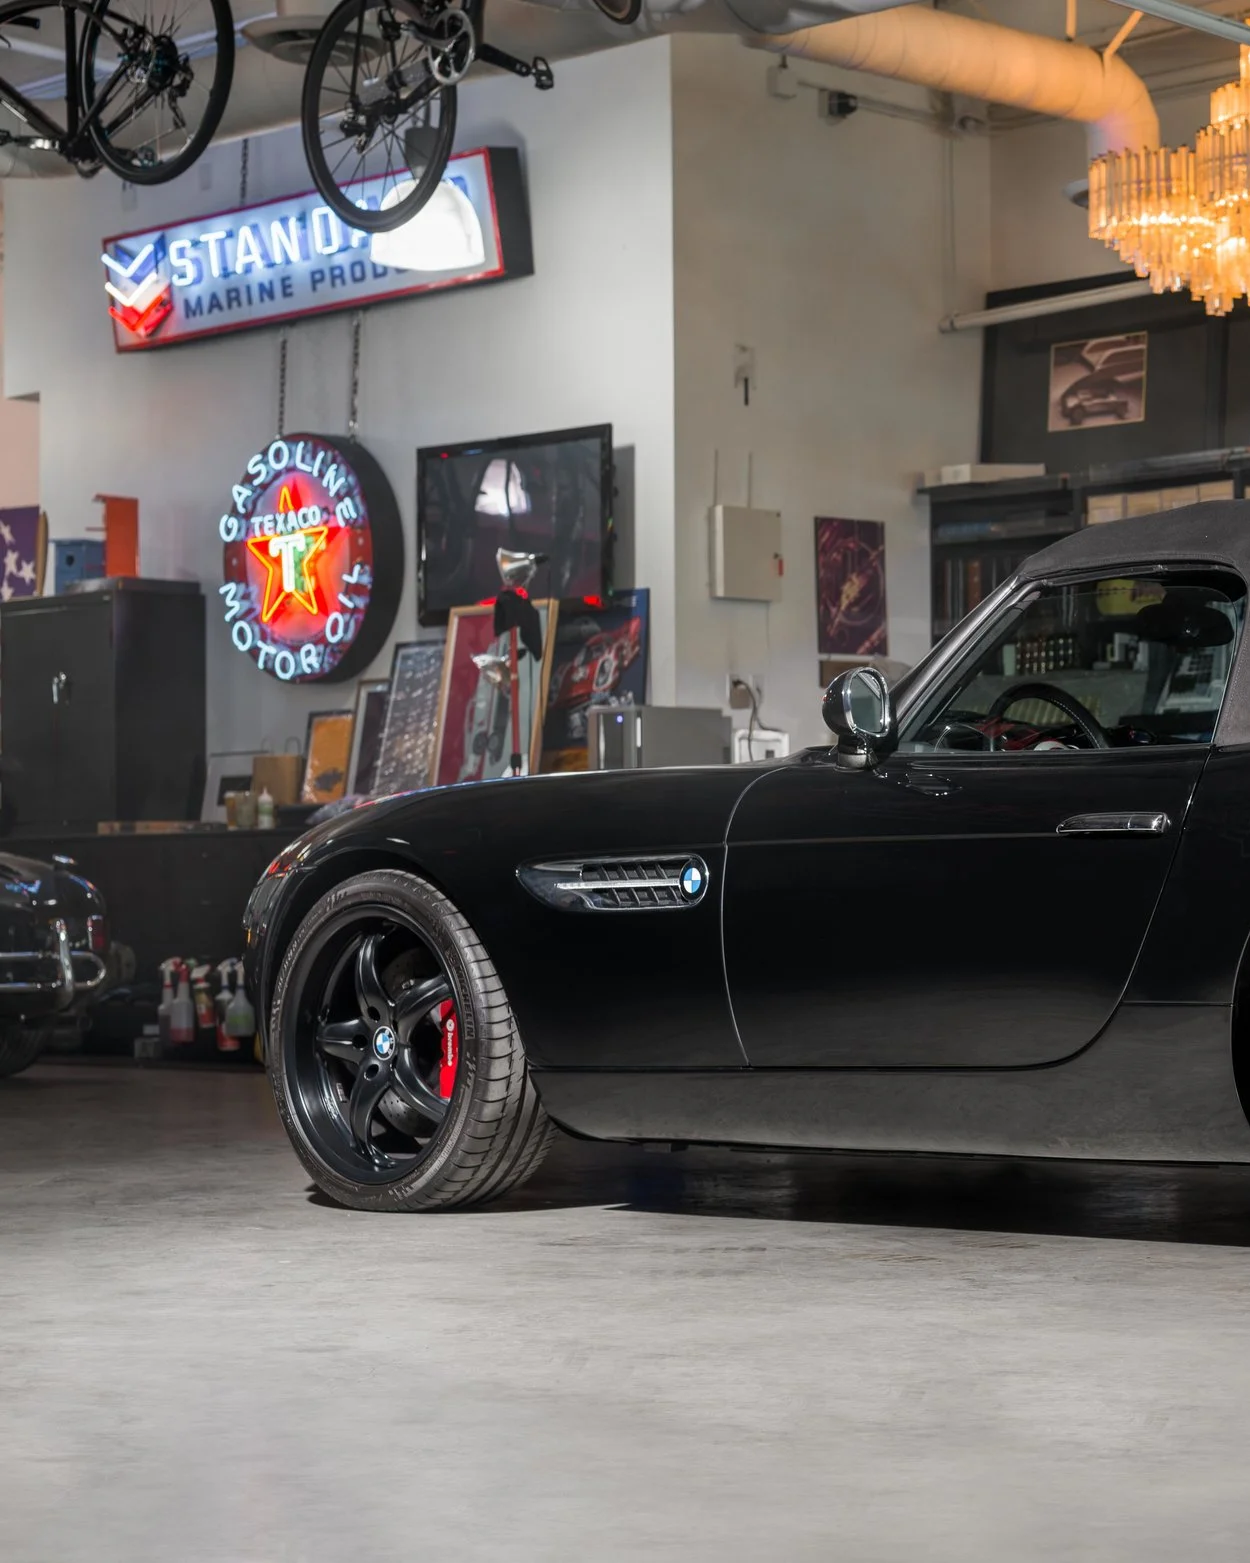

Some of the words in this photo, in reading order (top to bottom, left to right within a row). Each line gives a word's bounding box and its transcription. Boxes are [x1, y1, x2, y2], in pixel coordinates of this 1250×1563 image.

[183, 277, 294, 320] MARINE
[311, 258, 408, 293] PROD
[219, 440, 358, 543] GASOLINE
[251, 506, 322, 537] TEXACO
[269, 532, 306, 592] T
[219, 582, 319, 680] MOTOR
[325, 564, 362, 645] OIL
[446, 1032, 454, 1068] brembo
